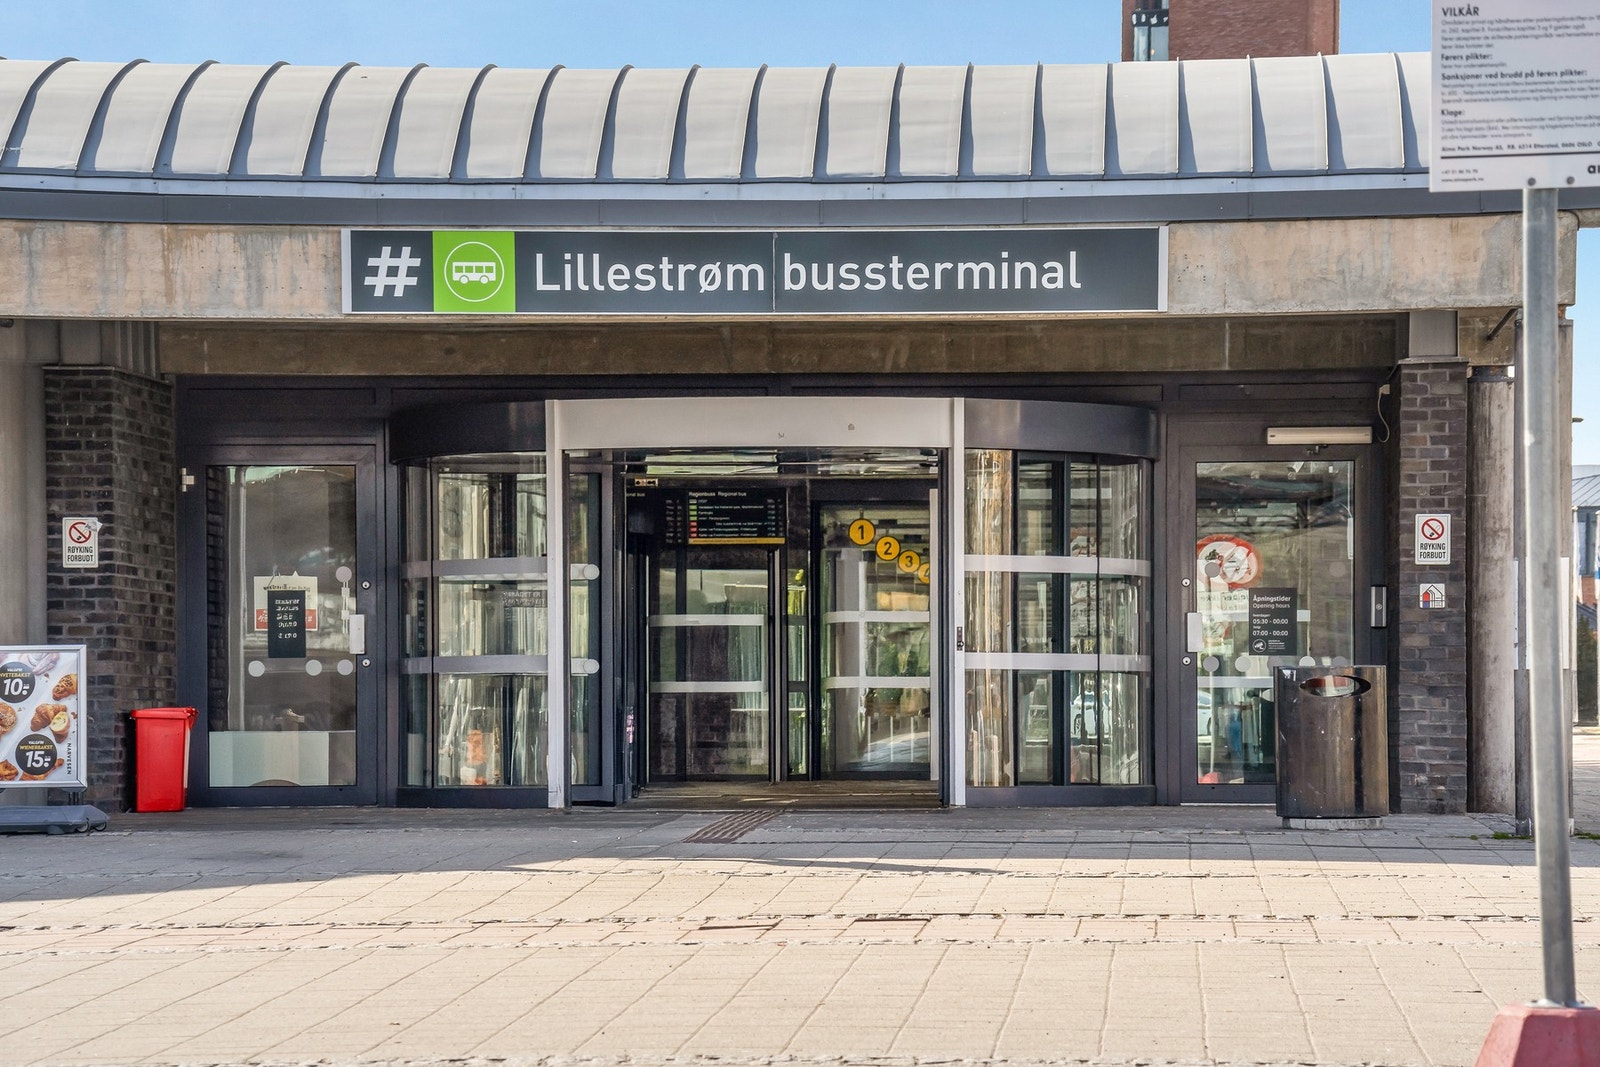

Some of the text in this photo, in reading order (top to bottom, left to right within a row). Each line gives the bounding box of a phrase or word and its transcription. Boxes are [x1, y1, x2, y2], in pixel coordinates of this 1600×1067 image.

[1441, 4, 1480, 17] VILKÅR
[1441, 72, 1482, 82] Sanksjoner
[1484, 71, 1499, 79] ved
[1500, 71, 1523, 79] brudd
[1525, 69, 1534, 79] på
[535, 252, 765, 293] Lillestrøm
[784, 251, 1081, 291] bussterminal
[857, 524, 865, 540] 1
[67, 546, 93, 554] RØYKING
[884, 541, 893, 556] 2
[1419, 542, 1446, 550] RØYKING
[67, 554, 94, 562] FORBUDT
[905, 555, 914, 568] 3
[1419, 551, 1446, 559] FORBUDT
[1252, 594, 1291, 603] Åpningstider
